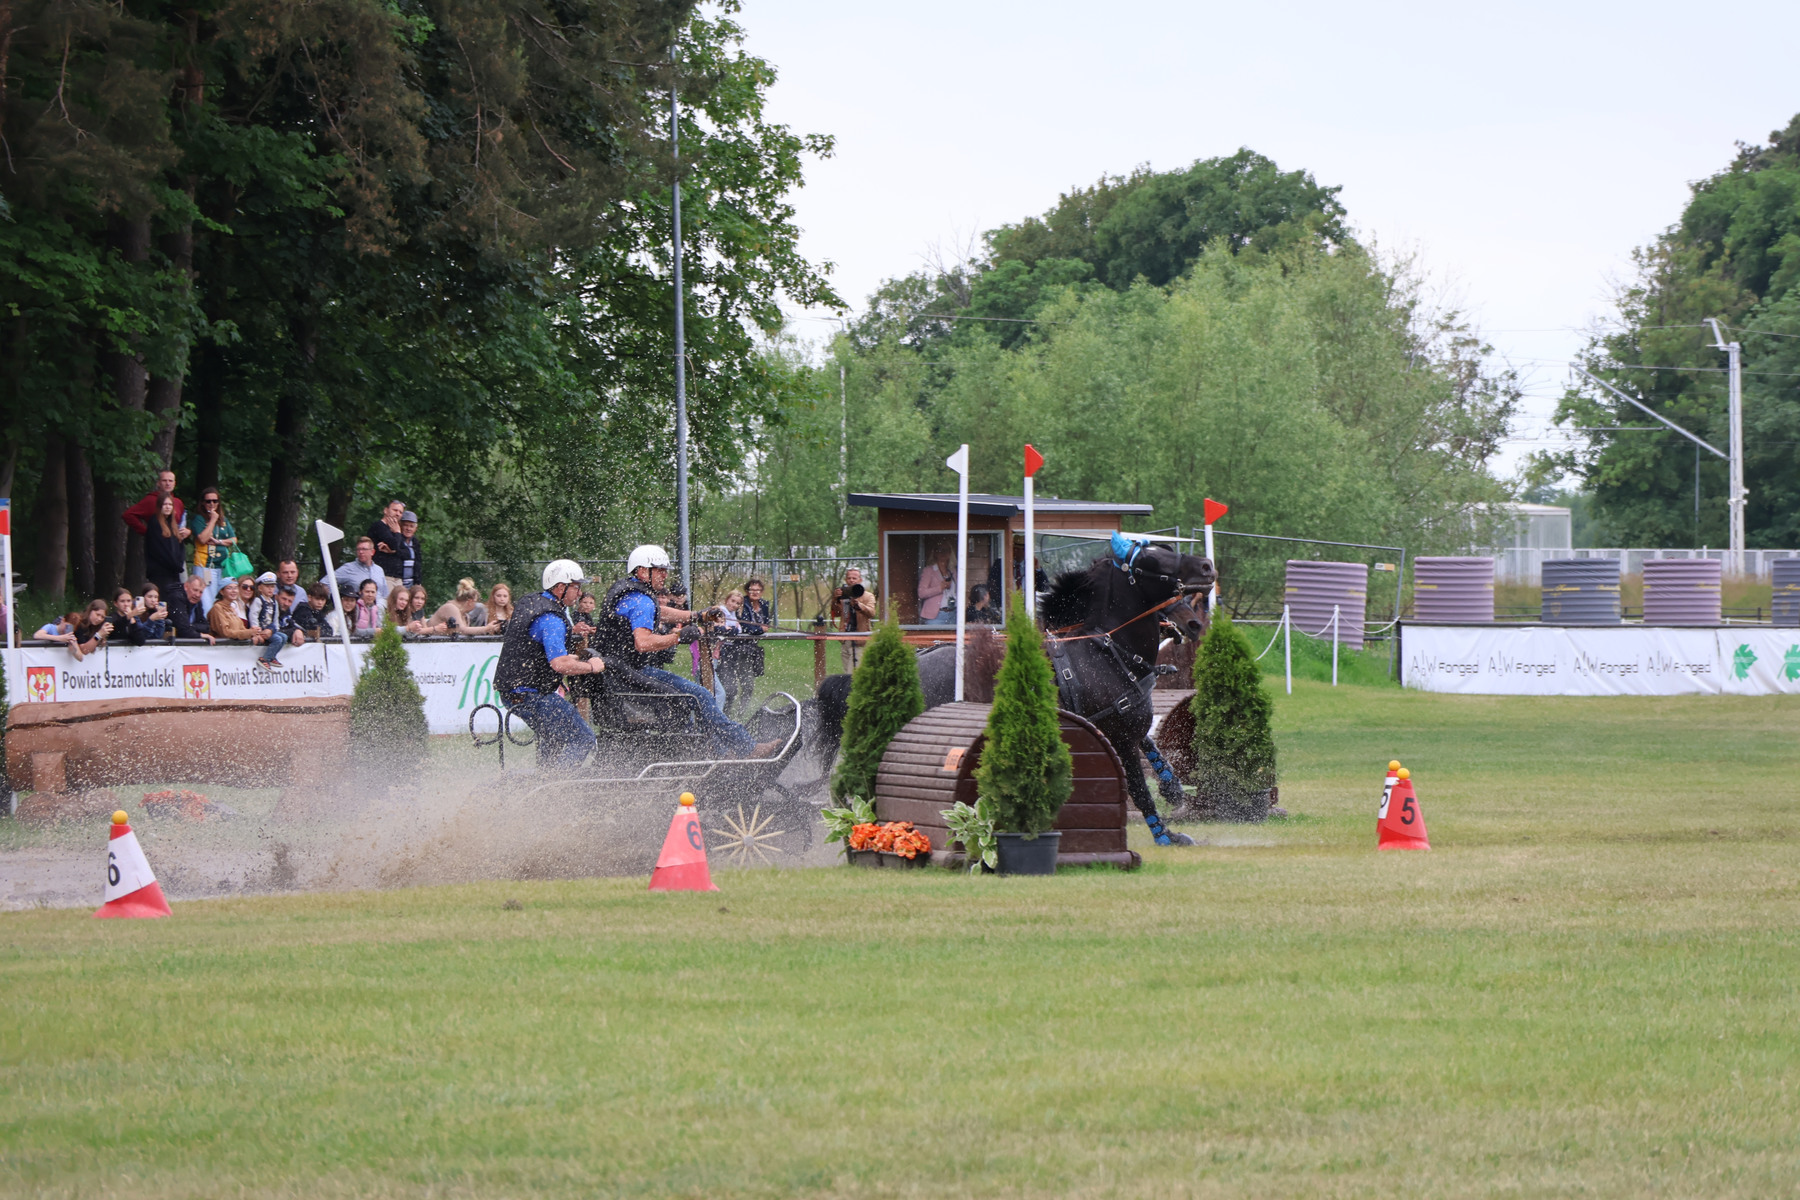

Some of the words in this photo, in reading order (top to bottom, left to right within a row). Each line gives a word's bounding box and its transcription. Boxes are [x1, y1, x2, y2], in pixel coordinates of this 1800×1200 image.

[62, 670, 102, 689] Powiat
[104, 668, 175, 689] Szamotulski
[215, 667, 251, 686] Powiat
[252, 665, 324, 685] Szamotulski
[1401, 797, 1415, 825] 5
[686, 821, 703, 851] 6
[108, 851, 120, 887] 6
